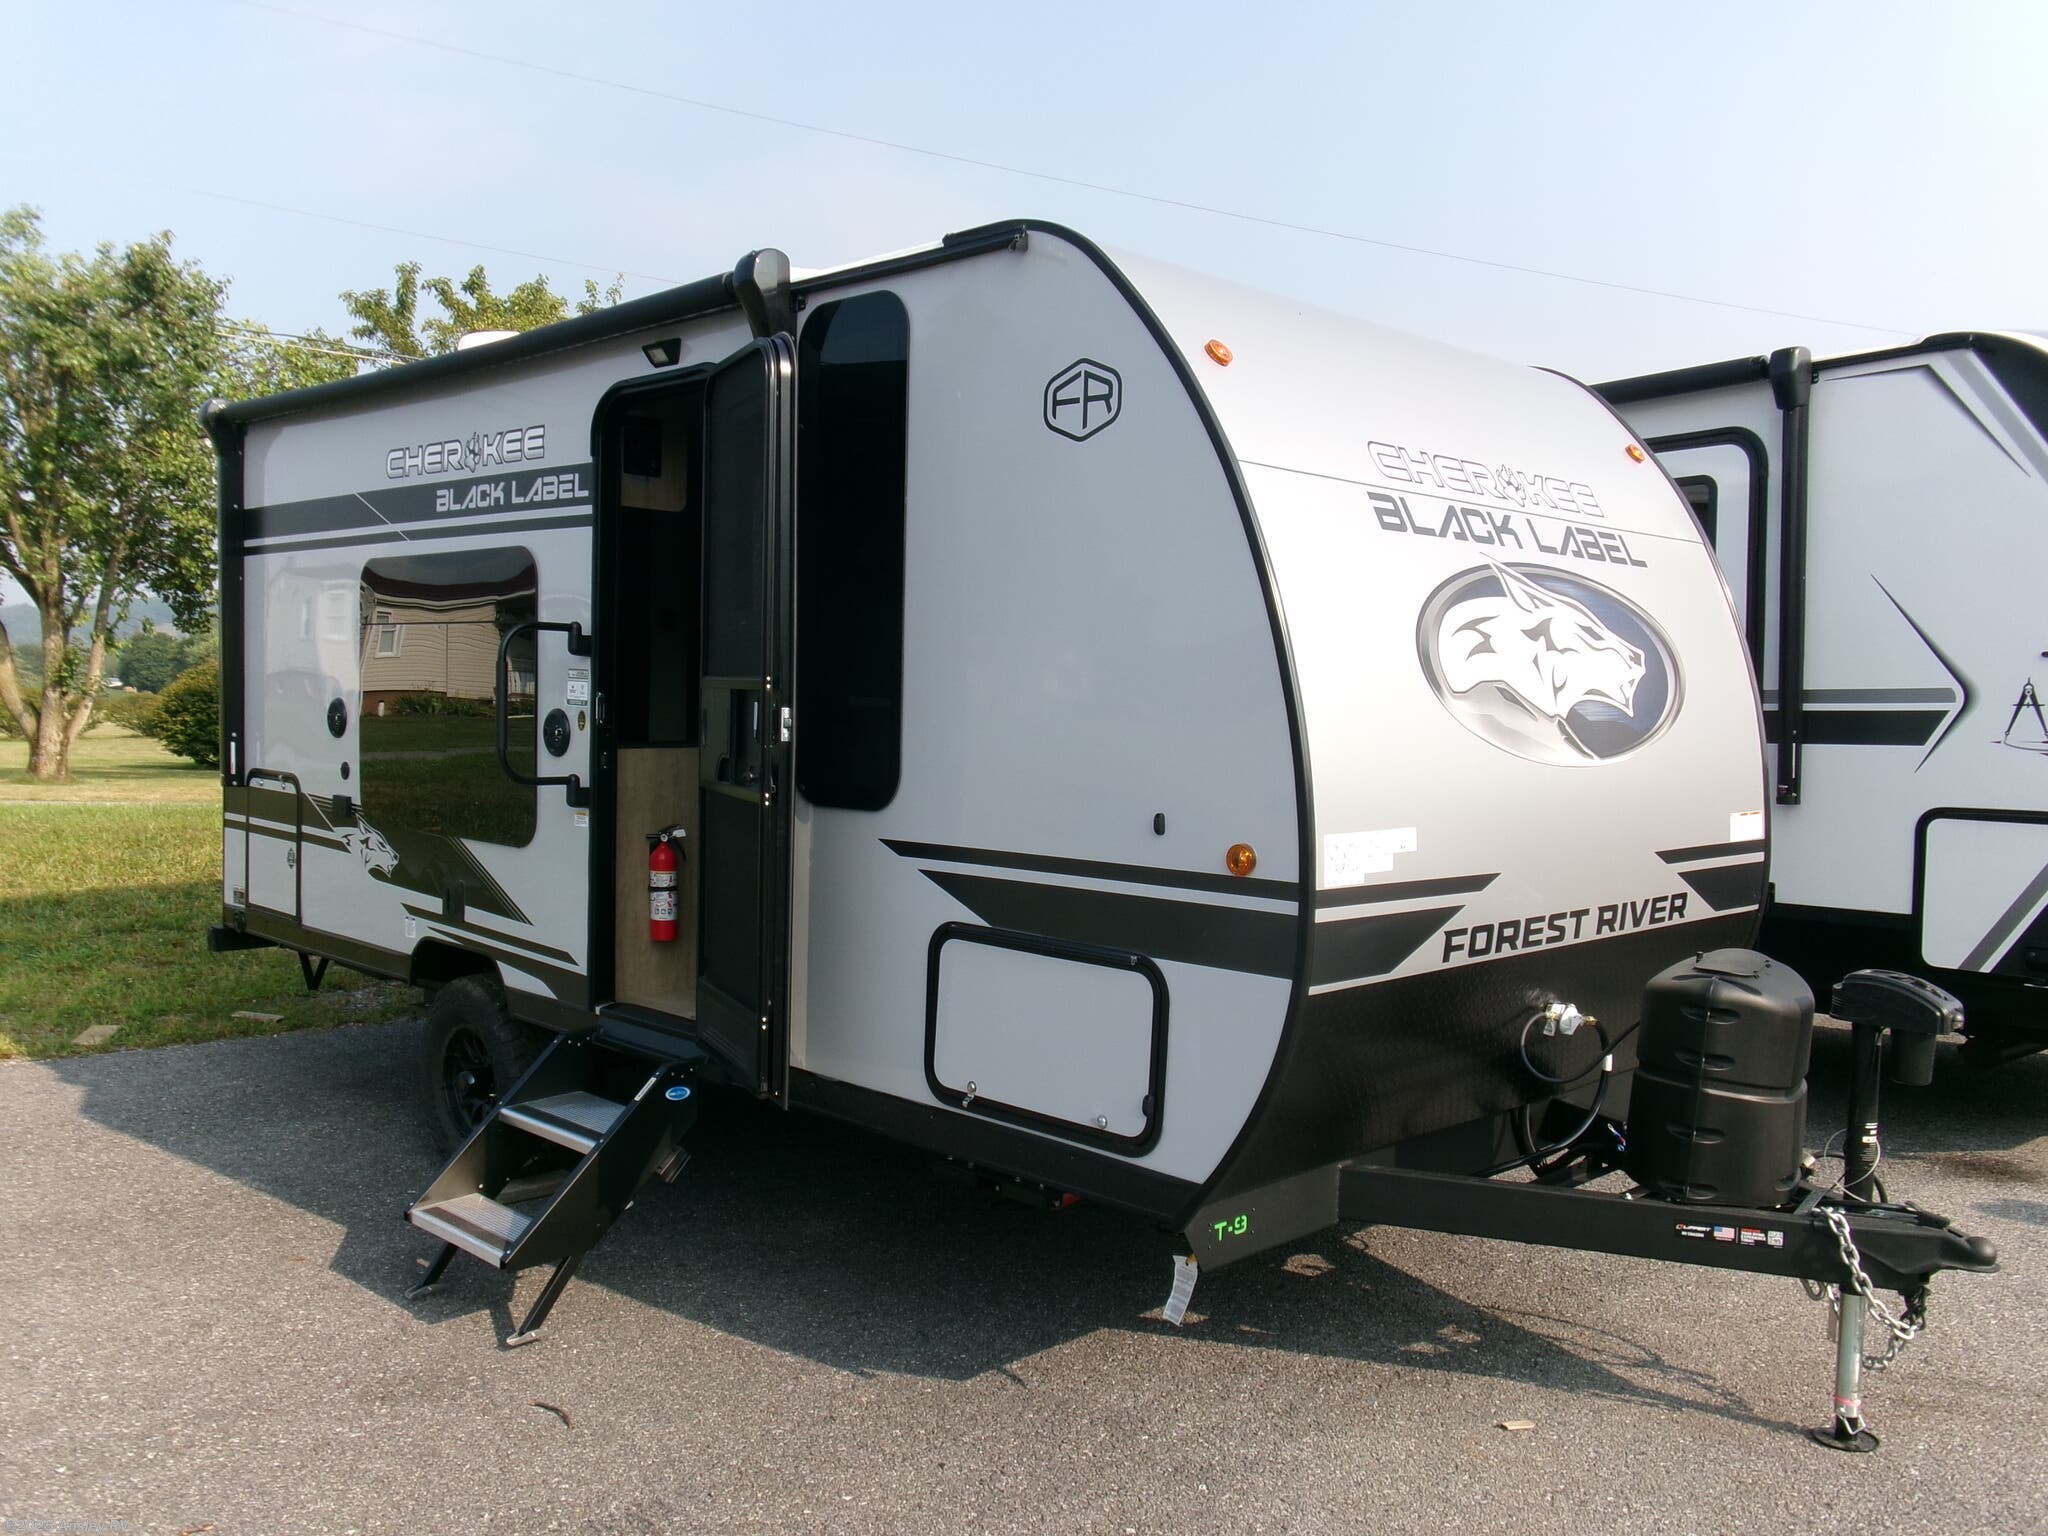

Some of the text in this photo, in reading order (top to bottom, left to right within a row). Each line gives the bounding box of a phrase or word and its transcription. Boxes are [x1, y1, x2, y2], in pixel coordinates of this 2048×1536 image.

[436, 472, 589, 513] BLACK LABEL
[1366, 491, 1648, 568] BLACK LABEL
[1442, 891, 1688, 964] FOREST RIVER
